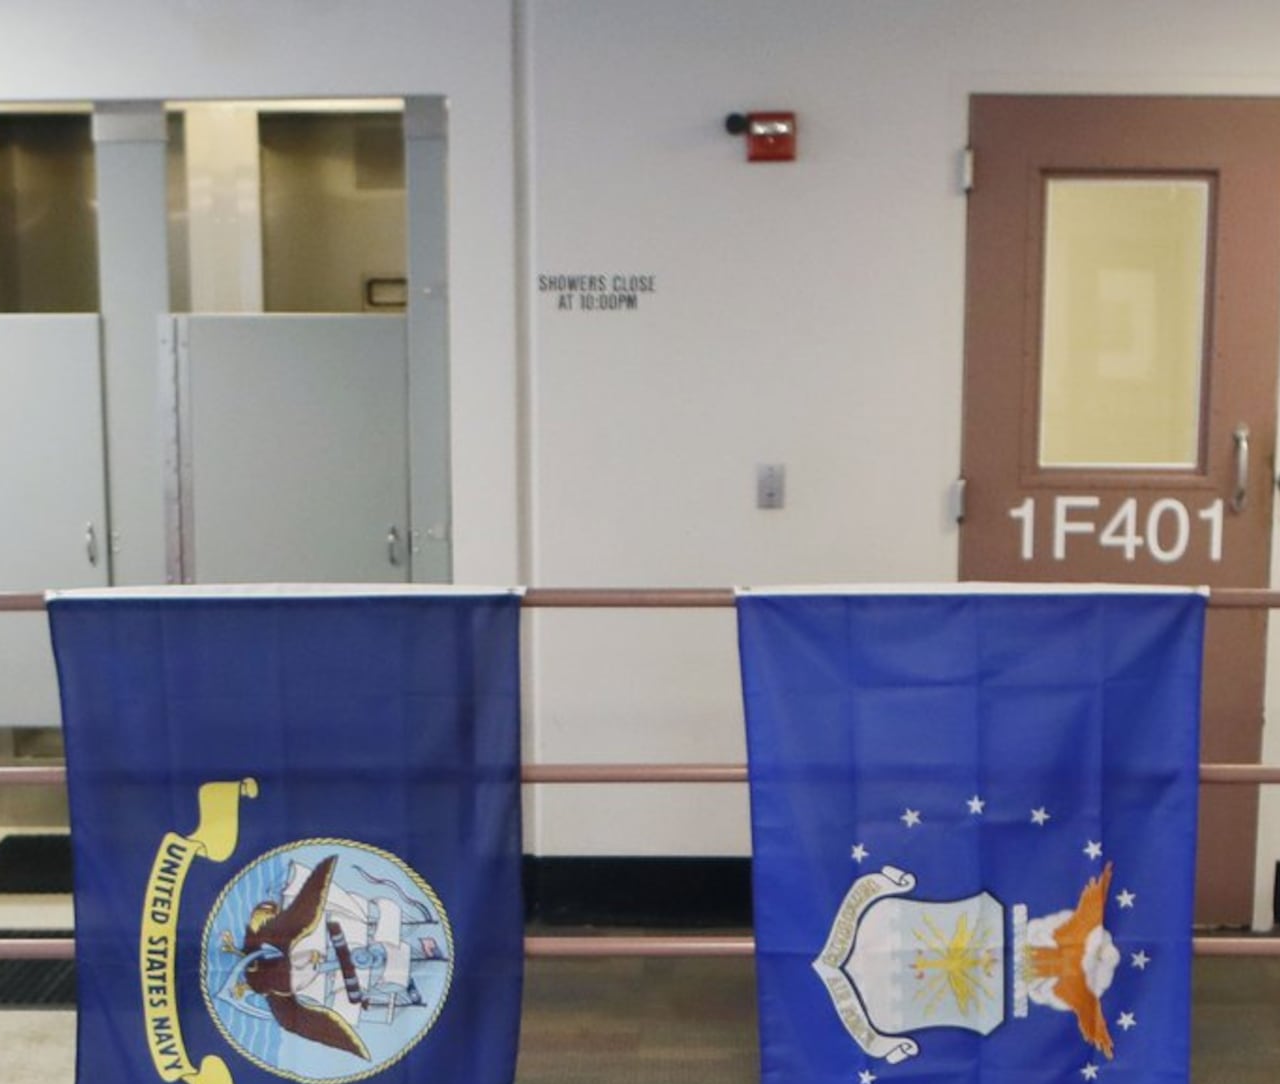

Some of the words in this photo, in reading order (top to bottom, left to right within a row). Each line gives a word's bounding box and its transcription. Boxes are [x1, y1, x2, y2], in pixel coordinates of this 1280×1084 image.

[537, 274, 608, 292] SHOWERS
[612, 274, 656, 292] CLOSE
[558, 293, 574, 310] AT
[580, 293, 638, 310] 10:00PM
[1008, 495, 1226, 564] 1F401
[152, 843, 186, 924] UNITED
[145, 935, 169, 1007] STATES
[152, 1016, 184, 1073] NAVY
